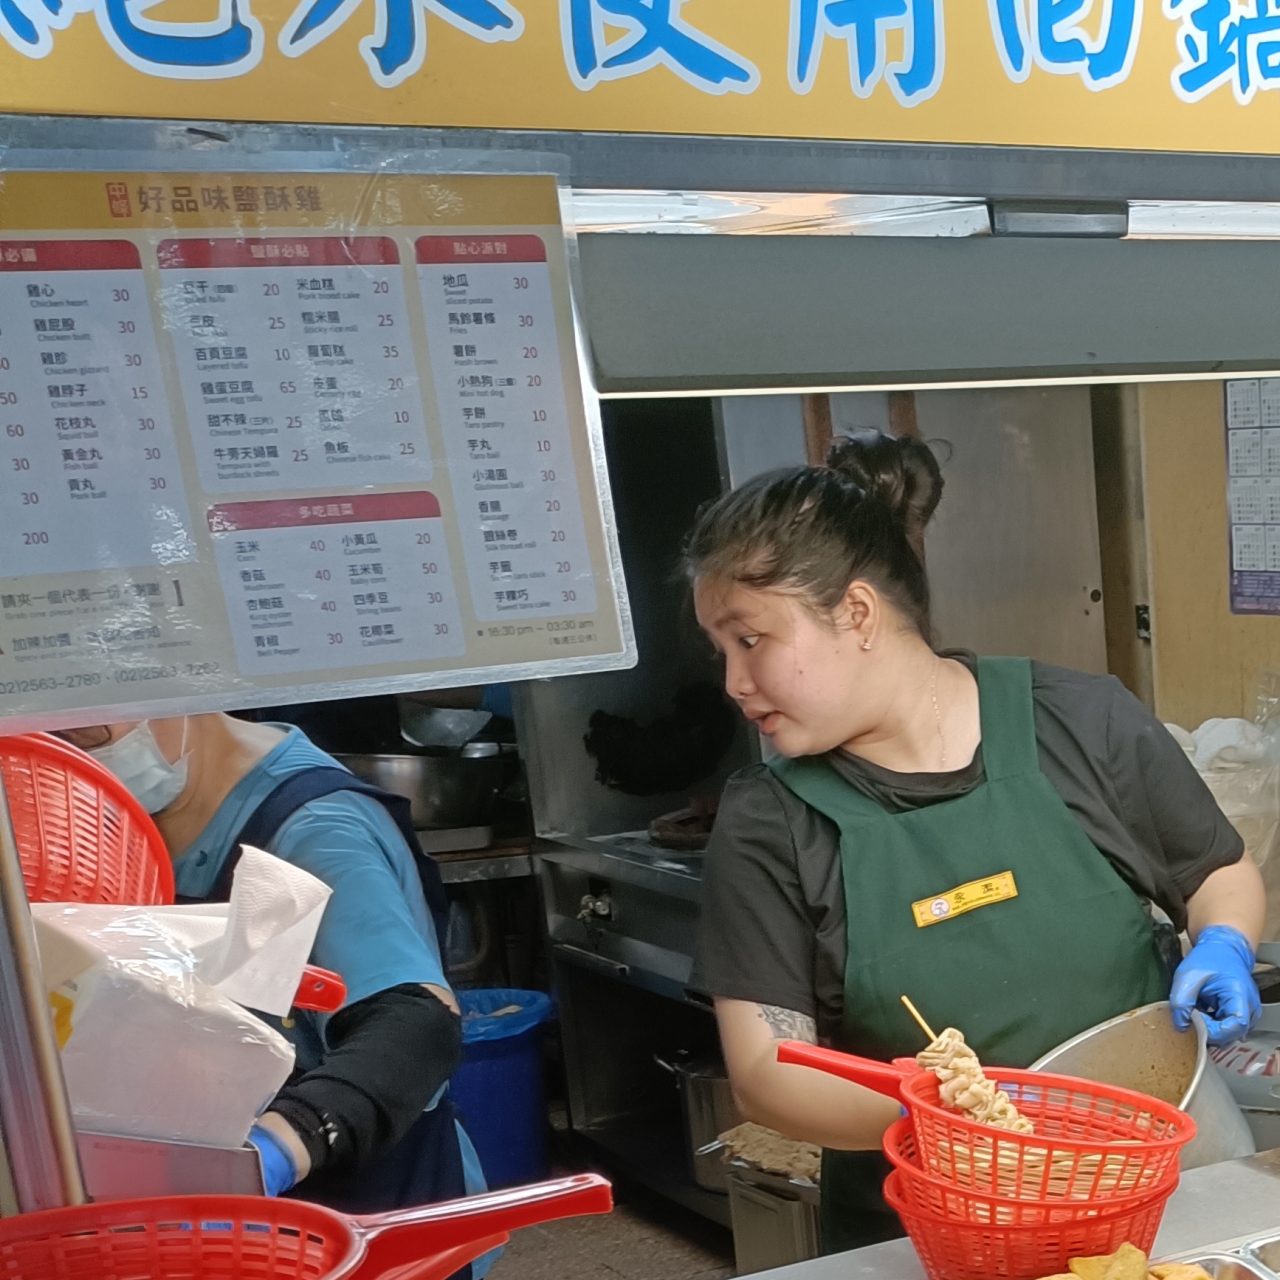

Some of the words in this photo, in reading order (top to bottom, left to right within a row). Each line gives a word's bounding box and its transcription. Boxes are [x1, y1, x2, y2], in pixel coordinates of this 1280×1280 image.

[137, 185, 322, 213] 好品味鹽酥雞
[453, 241, 507, 255] 點心派對
[296, 278, 335, 291] 米血糕
[372, 281, 389, 294] 20
[442, 274, 469, 288] 地瓜
[513, 277, 528, 290] 30
[26, 284, 55, 297] 雞心
[112, 289, 129, 301] 30
[262, 283, 280, 296] 20
[118, 321, 135, 333] 30
[269, 317, 285, 330] 25
[378, 314, 394, 327] 25
[518, 315, 534, 328] 30
[274, 348, 290, 361] 10
[383, 345, 400, 358] 35
[522, 346, 538, 358] 20
[125, 354, 142, 366] 30
[280, 381, 296, 394] 65
[388, 378, 404, 390] 20
[526, 375, 542, 387] 20
[132, 387, 148, 399] 15
[208, 414, 247, 427] 甜不辣
[286, 416, 302, 428] 25
[394, 411, 410, 424] 10
[532, 410, 547, 422] 10
[55, 416, 96, 430] 花枝丸
[138, 418, 155, 430] 30
[6, 425, 24, 437] 60
[400, 443, 415, 456] 25
[468, 438, 492, 451] 芋丸
[537, 440, 551, 452] 10
[62, 448, 103, 461] 黃金丸
[144, 448, 161, 460] 30
[292, 449, 308, 462] 25
[12, 458, 30, 471] 30
[541, 470, 556, 482] 30
[150, 477, 166, 490] 30
[21, 492, 39, 505] 30
[545, 500, 560, 512] 20
[23, 532, 49, 545] 200
[342, 532, 378, 547] 小黃瓜
[416, 532, 431, 545] 20
[551, 530, 566, 542] 20
[235, 541, 261, 554] 玉米
[310, 539, 326, 552] 40
[422, 562, 438, 575] 50
[556, 561, 571, 573] 20
[240, 569, 266, 582] 香菇
[315, 569, 331, 582] 40
[353, 592, 390, 606] 四季豆
[427, 592, 442, 604] 30
[561, 590, 576, 602] 30
[320, 600, 336, 612] 40
[434, 623, 448, 636] 30
[327, 632, 343, 645] 30
